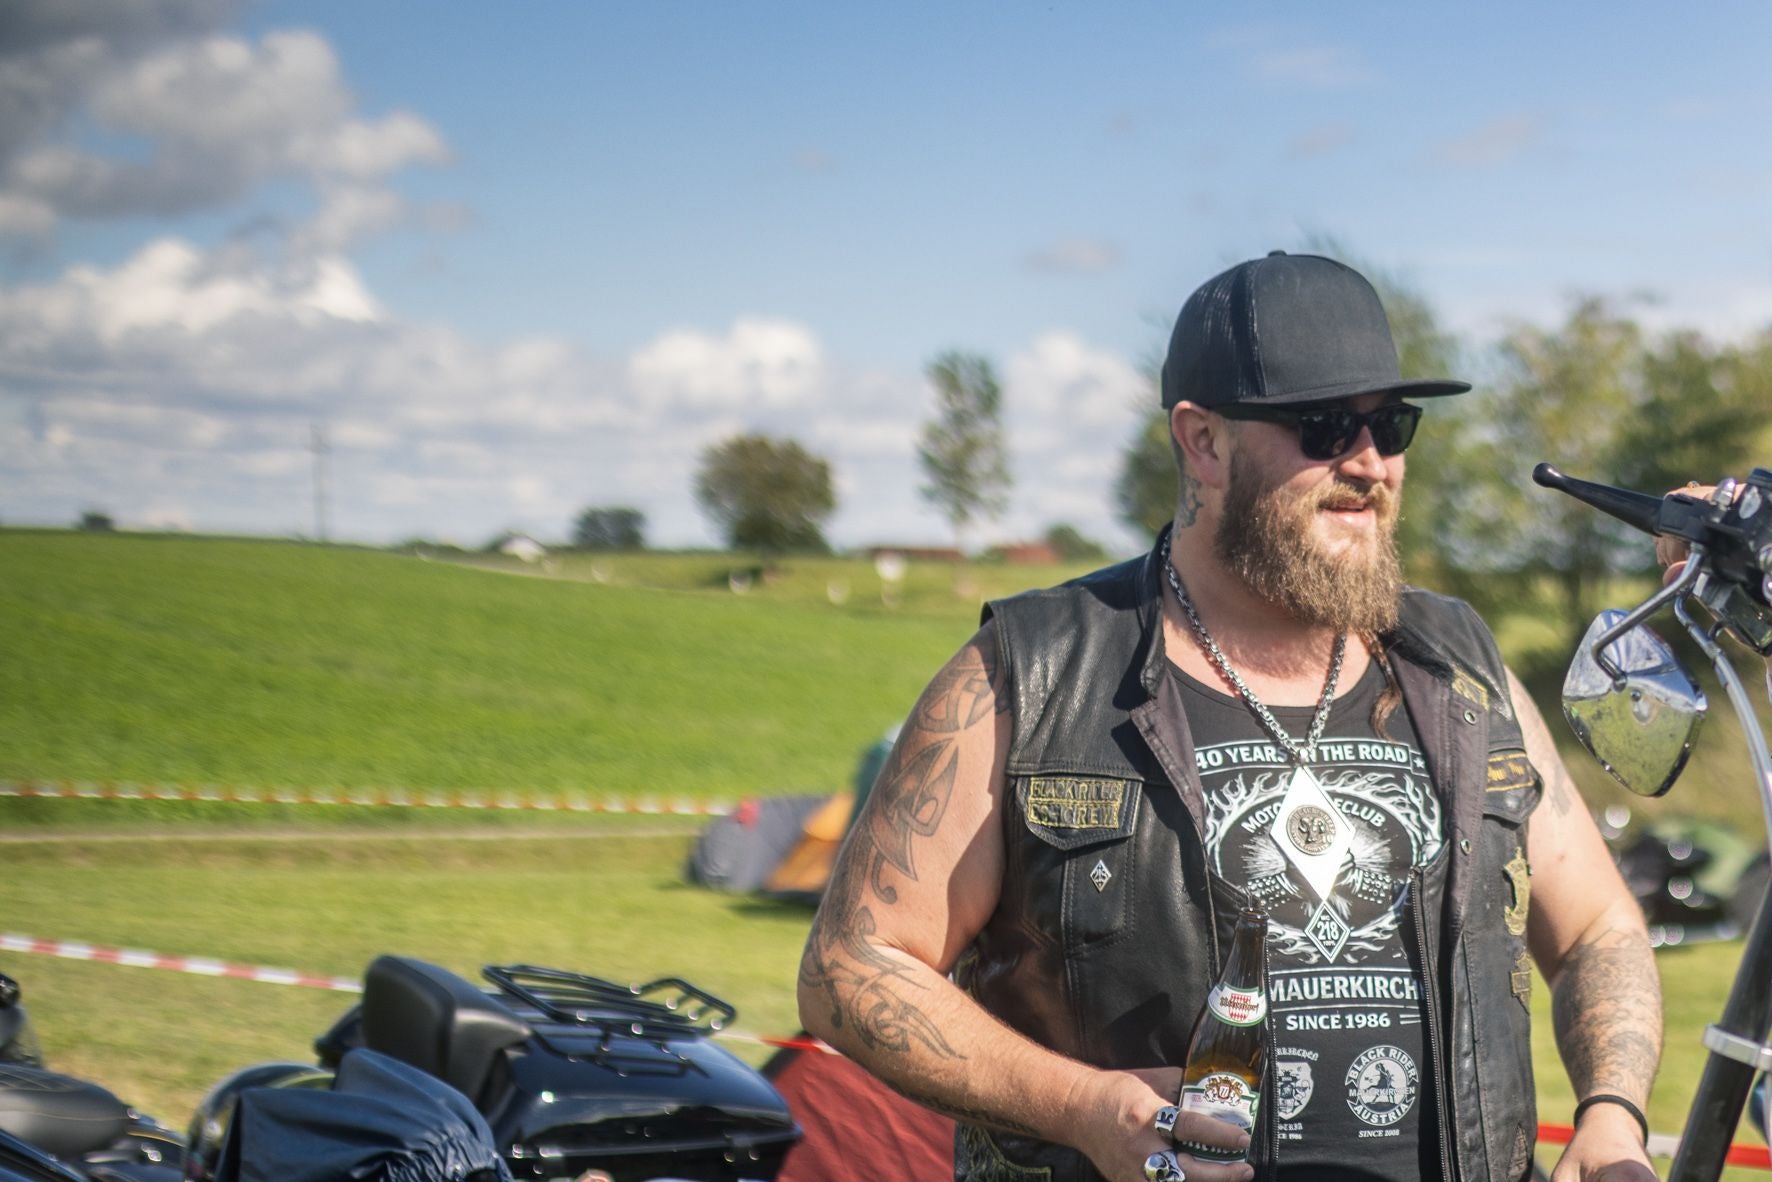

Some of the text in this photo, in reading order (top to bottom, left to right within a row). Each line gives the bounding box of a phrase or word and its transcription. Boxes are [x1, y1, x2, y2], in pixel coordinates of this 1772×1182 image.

[1195, 749, 1223, 769] 40
[1224, 745, 1288, 764] YEARS
[1319, 744, 1356, 761] THE
[1358, 744, 1408, 763] ROAD
[1317, 921, 1339, 940] 218
[1270, 975, 1420, 1002] MAUERKIRCH
[1286, 1012, 1391, 1031] SINCE 1986
[1349, 1047, 1417, 1079] BLACK RIDER
[1353, 1103, 1409, 1124] AUSTRIA
[1358, 1130, 1383, 1138] SINCE
